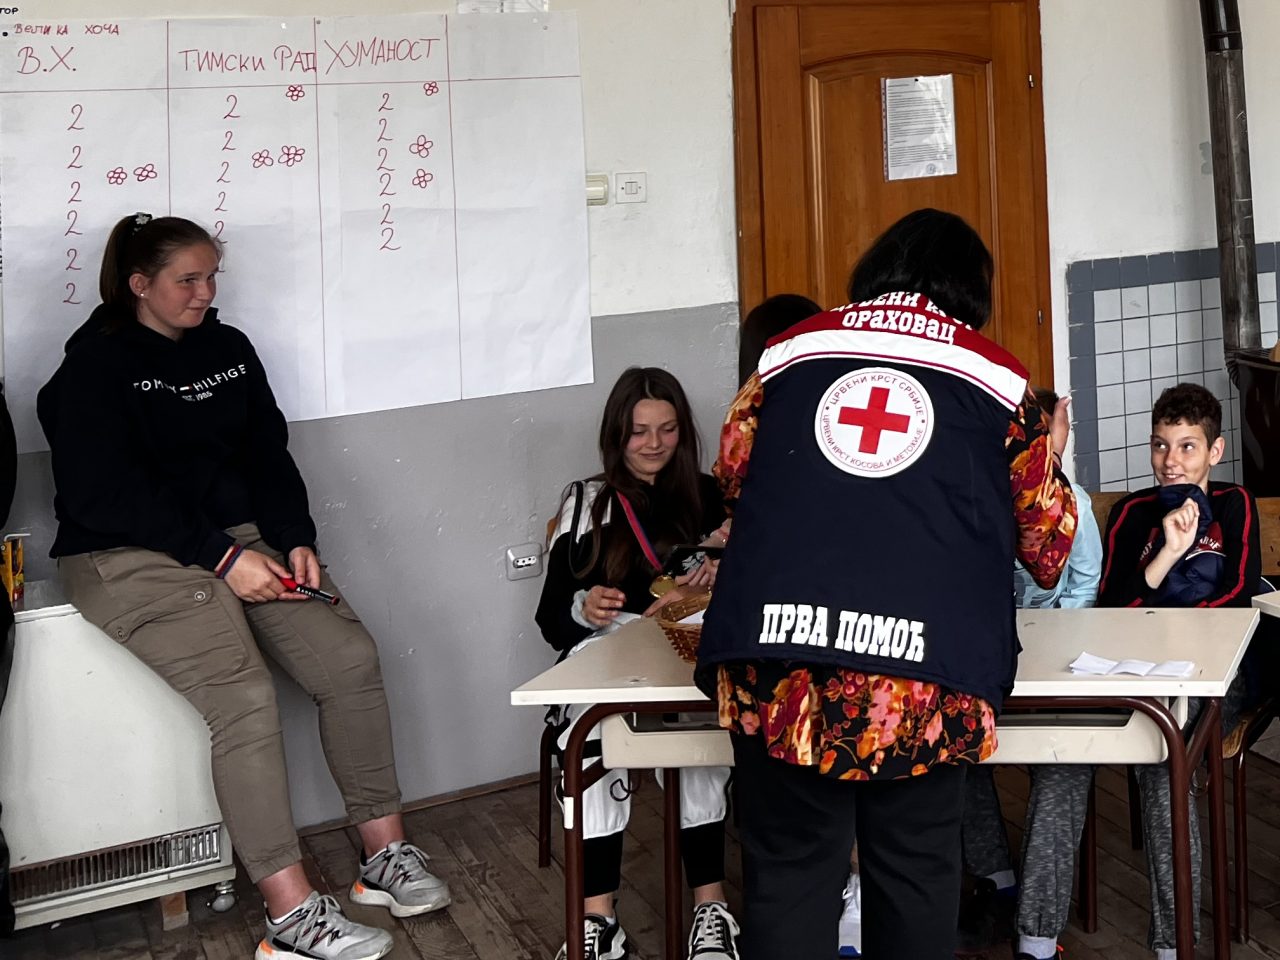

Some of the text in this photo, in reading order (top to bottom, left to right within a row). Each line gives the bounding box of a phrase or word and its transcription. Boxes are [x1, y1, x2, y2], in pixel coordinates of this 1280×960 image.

[85, 23, 119, 36] ХОЧА
[17, 46, 77, 74] В.Х.
[178, 44, 317, 74] ТИМСКИ РАД
[324, 36, 441, 76] ХУМАНОСТ
[223, 94, 241, 119] 2
[378, 93, 394, 113] 2
[67, 104, 84, 130] 2
[222, 131, 236, 151] 2
[377, 118, 393, 142] 2
[67, 145, 83, 169] 2
[377, 147, 396, 171] 2
[216, 161, 231, 184] 2
[379, 173, 397, 196] 2
[68, 181, 82, 204] 2
[214, 191, 228, 212] 2
[65, 210, 83, 236] 2
[380, 203, 394, 225] 2
[214, 220, 228, 244] 2
[379, 227, 402, 251] 2
[66, 248, 82, 271] 2
[63, 282, 82, 305] 2
[829, 374, 925, 416] ЦРВЕНИ КРСТ СРБИЈЕ
[822, 414, 836, 447] ЦРВЕНИ
[832, 444, 851, 462] КРСТ
[849, 457, 885, 470] КОСОВА
[886, 458, 893, 467] И
[758, 603, 926, 663] ПРВА ПОМОЋ
